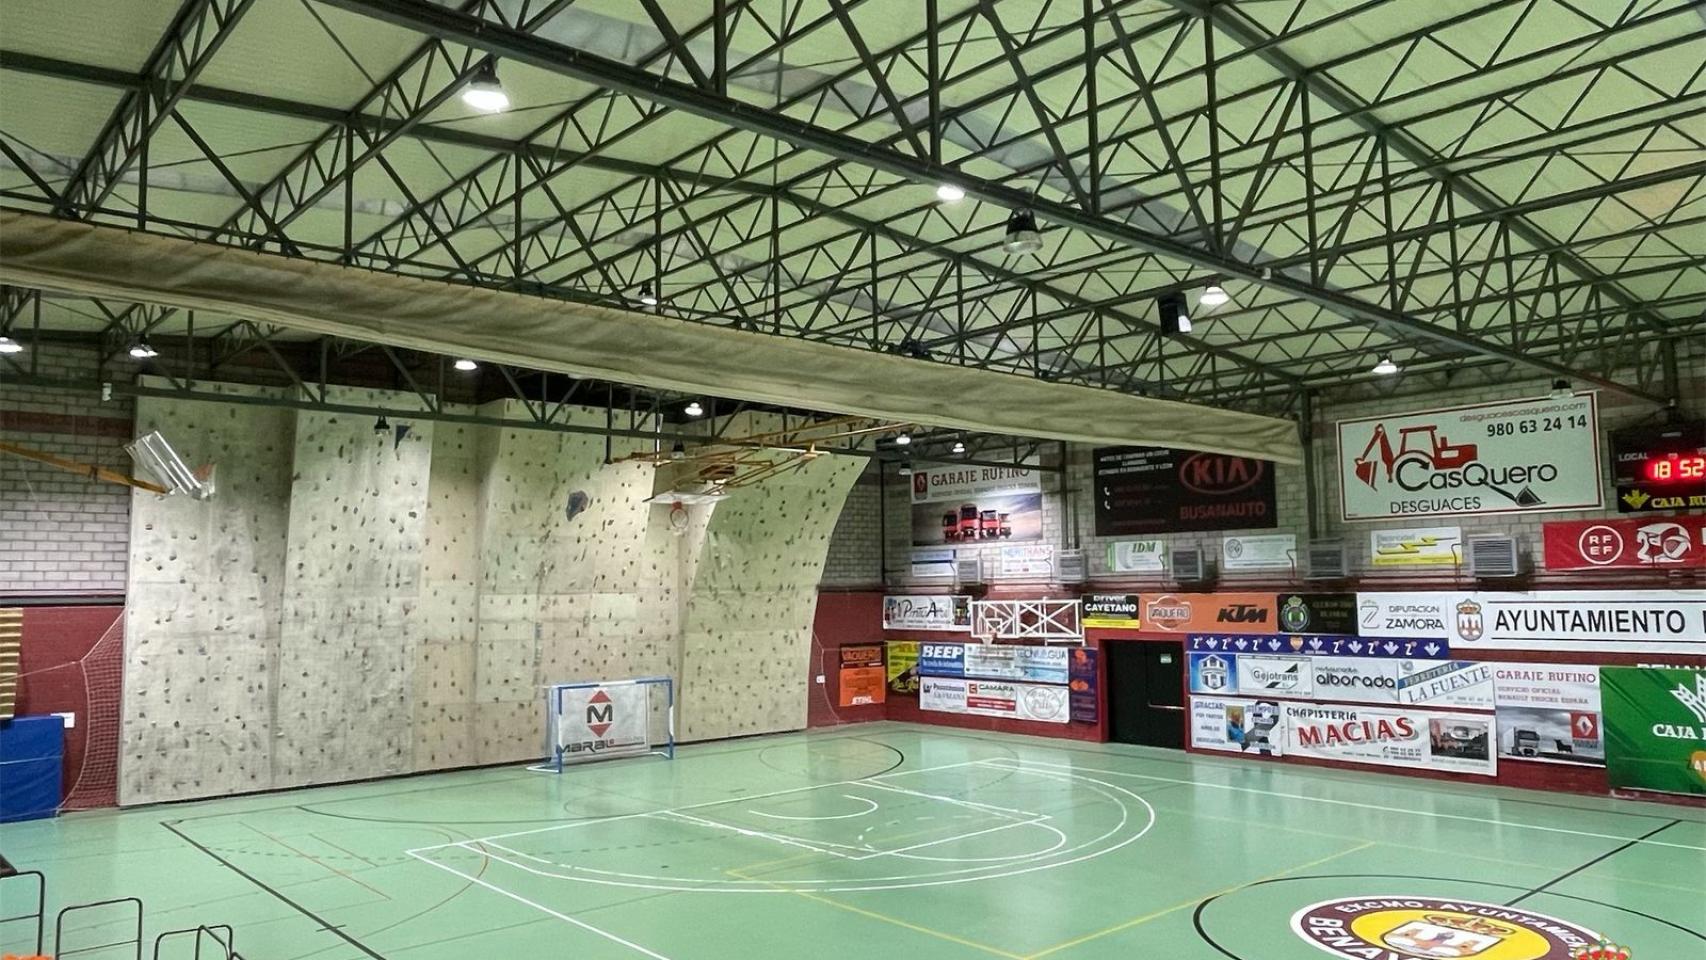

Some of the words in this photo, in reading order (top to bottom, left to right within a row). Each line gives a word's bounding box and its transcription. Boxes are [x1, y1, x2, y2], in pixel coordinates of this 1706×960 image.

[1487, 421, 1514, 437] 980
[1519, 420, 1537, 434] 63
[1543, 417, 1562, 432] 24
[1567, 414, 1588, 429] 14
[1618, 452, 1649, 462] LOCAL
[931, 470, 977, 487] GARAJE
[982, 467, 1031, 481] RUFINO
[1193, 457, 1249, 485] KIA
[1653, 460, 1672, 479] 18
[1679, 457, 1705, 478] 52
[1179, 501, 1267, 520] BUSANAUTO
[1390, 496, 1482, 514] DESGUACES
[1651, 496, 1686, 508] CAJA
[1132, 541, 1156, 553] IDM
[1084, 603, 1137, 613] CAYETANO
[1216, 604, 1268, 623] KTM
[1385, 618, 1445, 631] ZAMORA
[1495, 609, 1686, 634] AYUNTAMIENTO
[922, 644, 964, 659] BEEP
[1316, 673, 1396, 690] alborada
[1408, 686, 1428, 703] LA
[1430, 665, 1492, 696] FUENTE
[1496, 669, 1544, 682] GARAJE
[1548, 671, 1597, 684] RUFINO
[586, 703, 613, 724] M
[1286, 706, 1357, 721] CHAPISTERIA
[1297, 716, 1417, 749] MACIAS
[1652, 723, 1699, 740] CAJA
